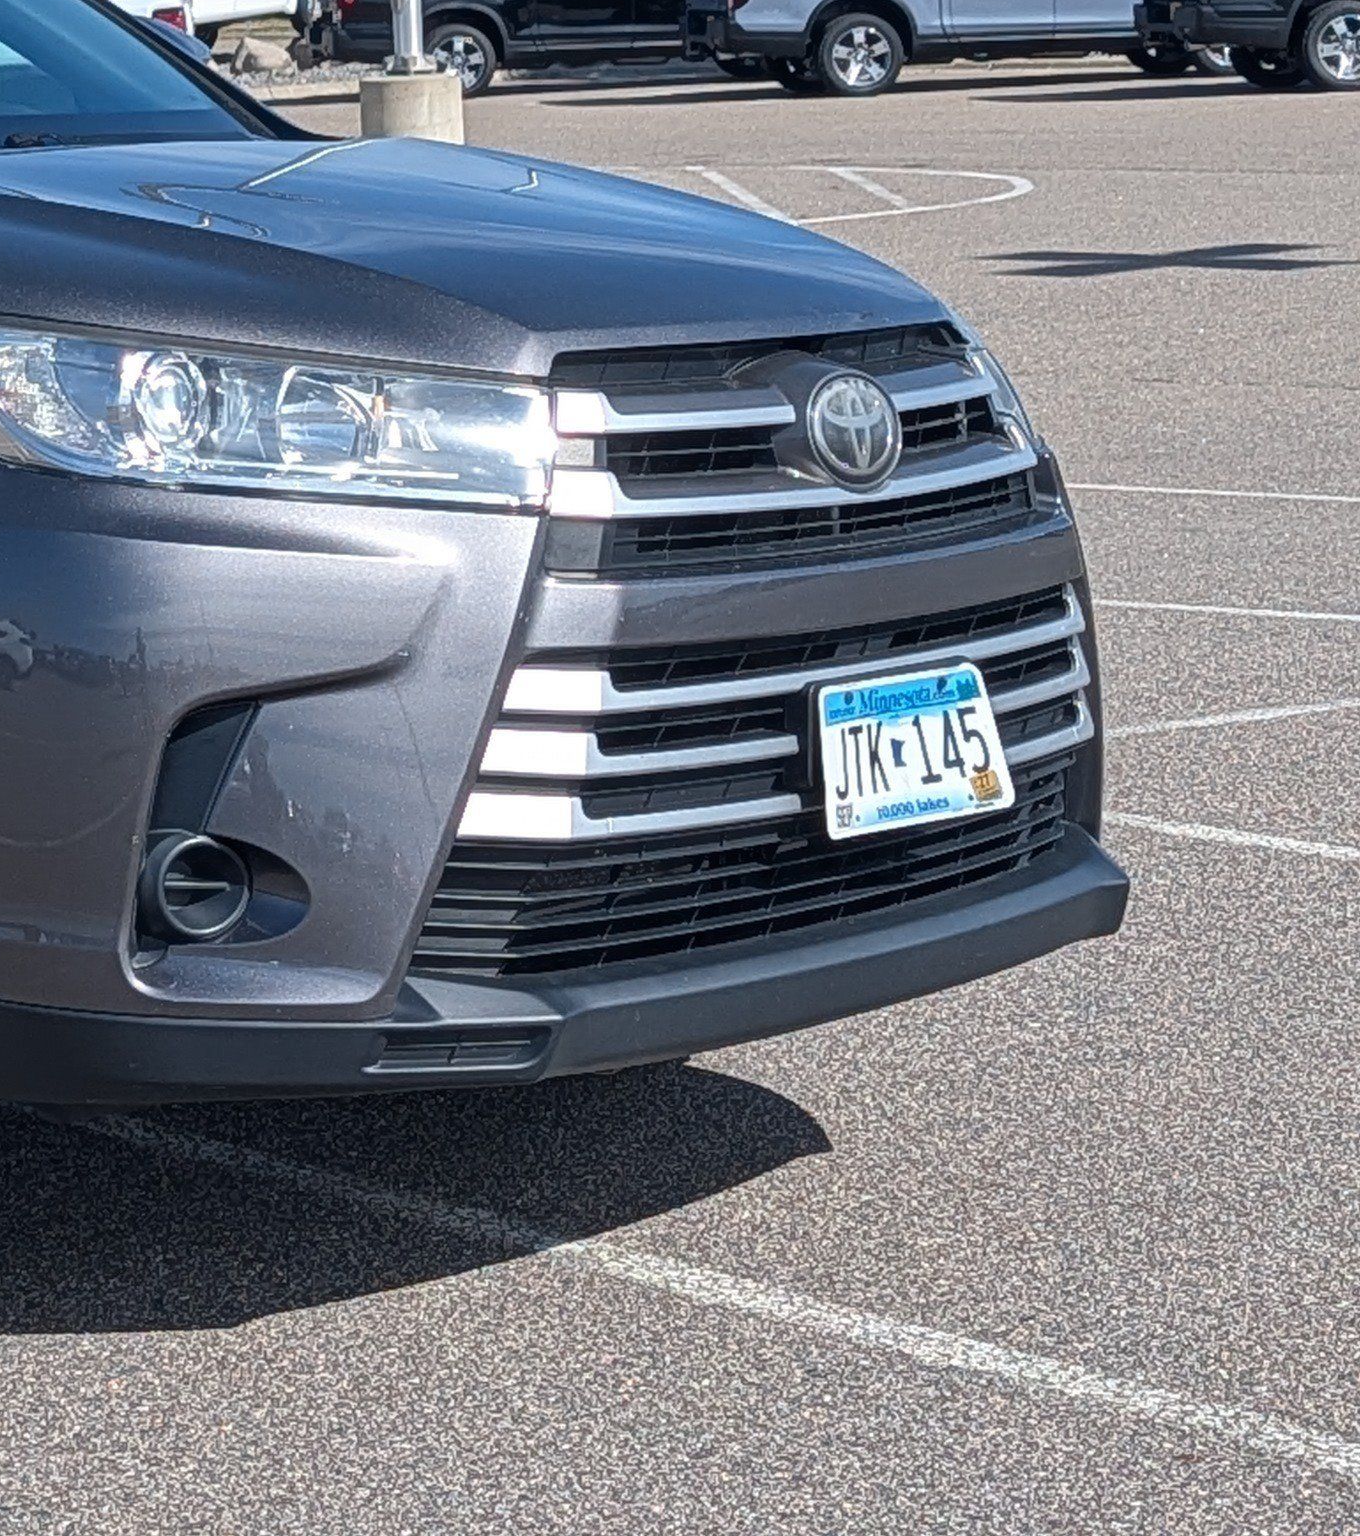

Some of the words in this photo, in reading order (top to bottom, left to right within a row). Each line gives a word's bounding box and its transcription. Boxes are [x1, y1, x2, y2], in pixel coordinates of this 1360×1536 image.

[859, 685, 931, 713] Minnesota
[836, 721, 891, 800] JTK
[912, 706, 990, 785] 145
